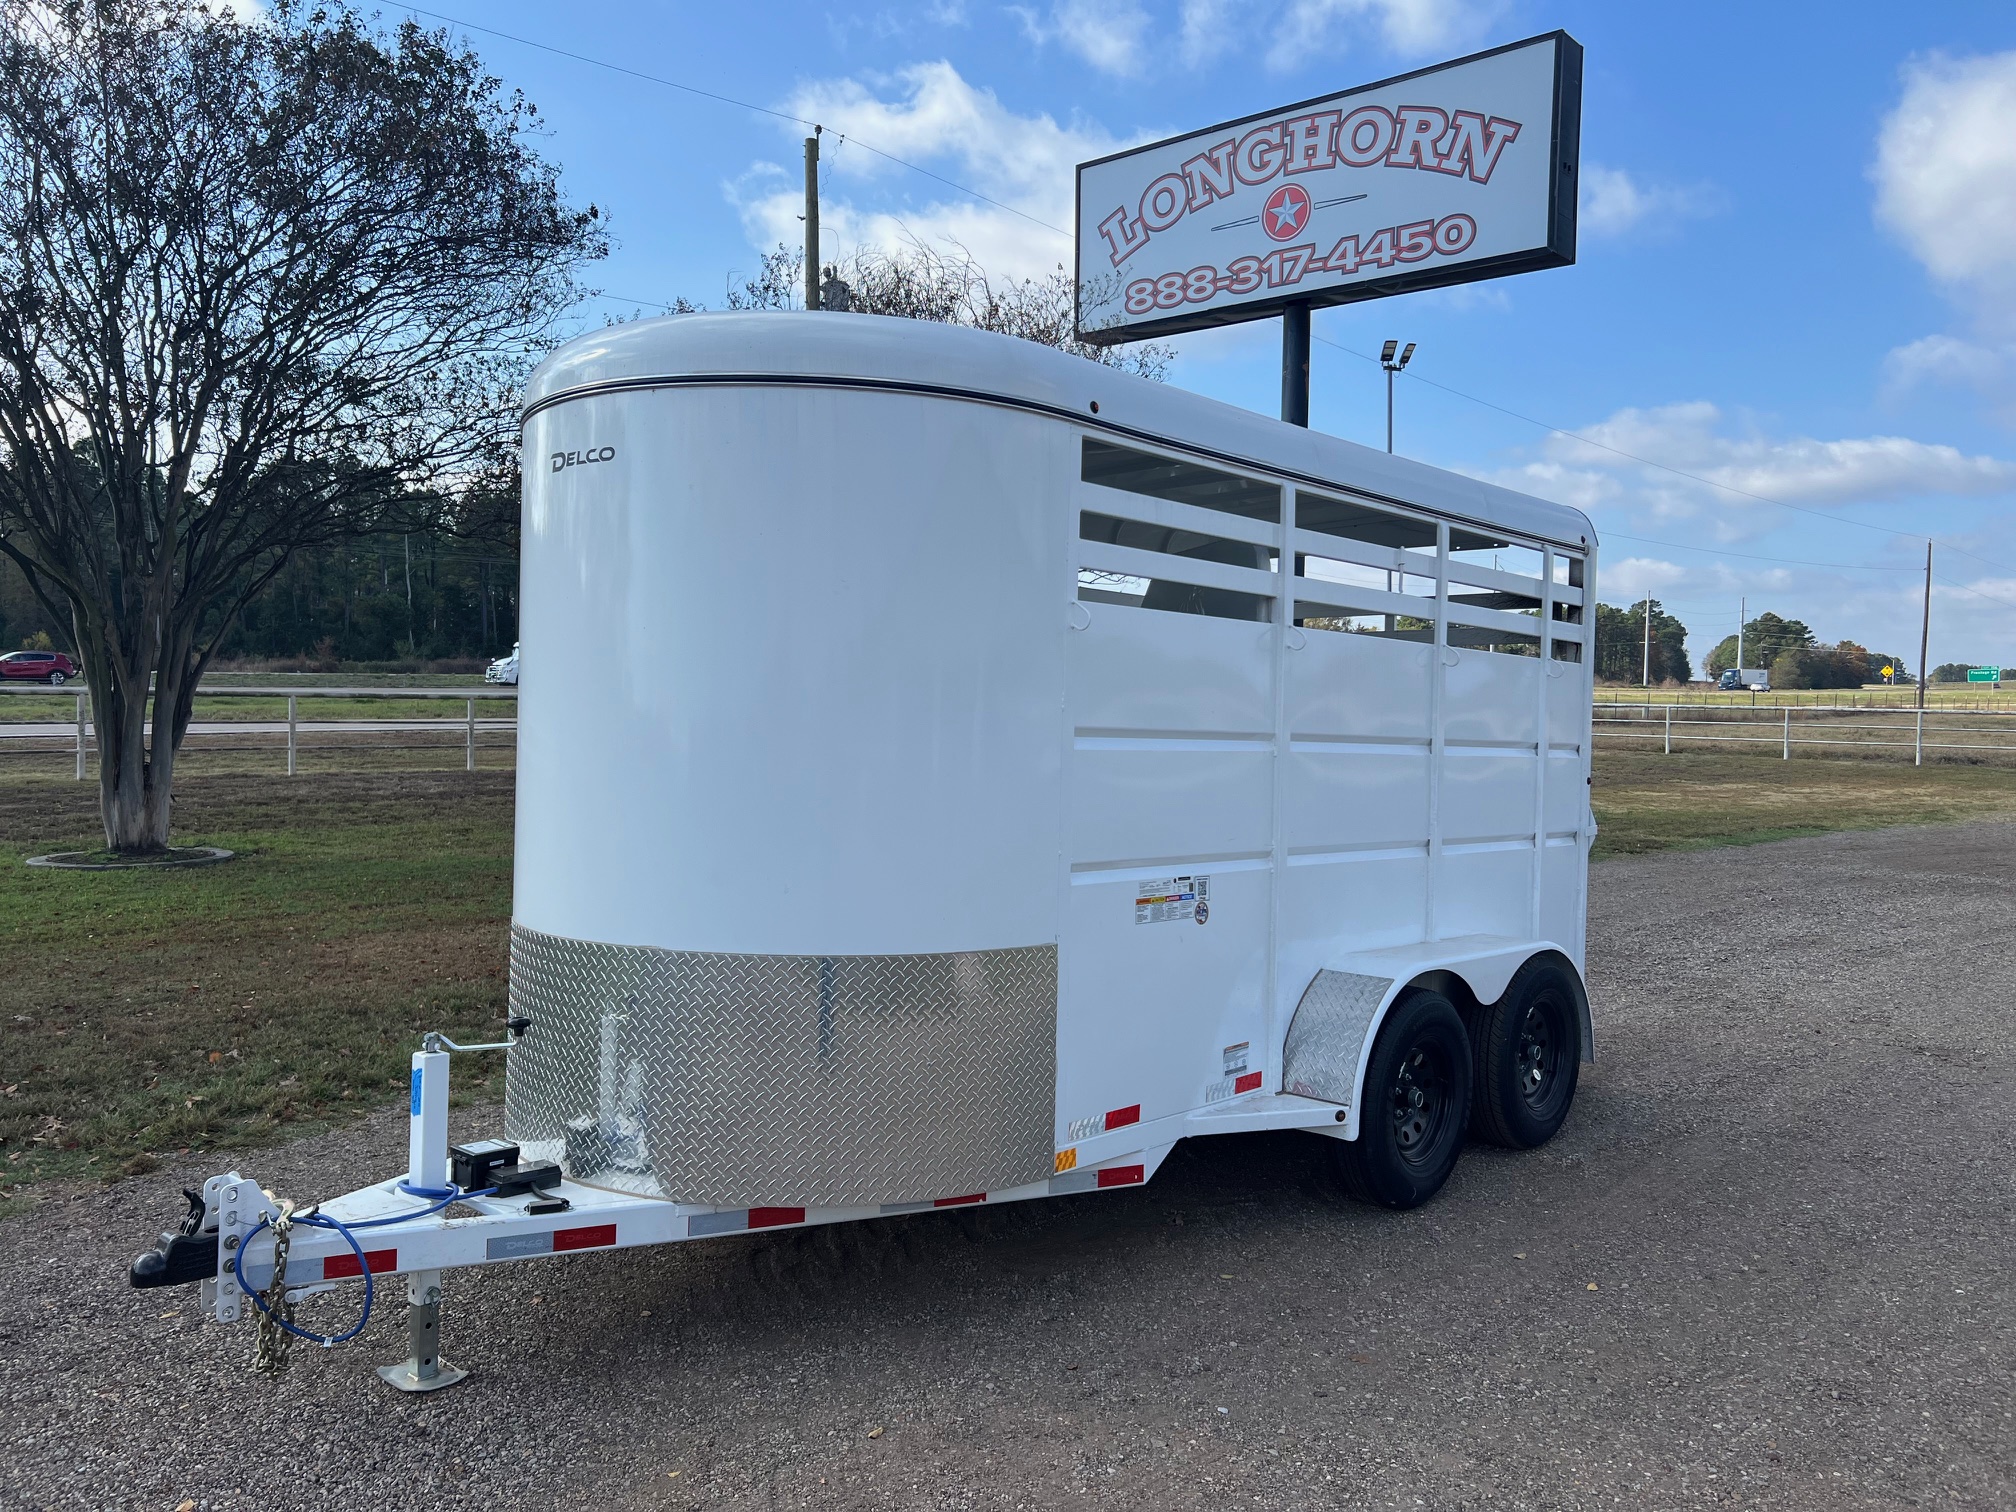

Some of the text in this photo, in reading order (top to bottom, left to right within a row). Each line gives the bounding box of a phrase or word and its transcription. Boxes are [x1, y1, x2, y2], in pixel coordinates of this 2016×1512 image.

[1098, 105, 1522, 267] LONGHORN
[1124, 213, 1477, 315] 888-317-4450
[550, 446, 616, 473] DELCO
[565, 1232, 602, 1243] DELCO
[337, 1258, 380, 1270] DELO
